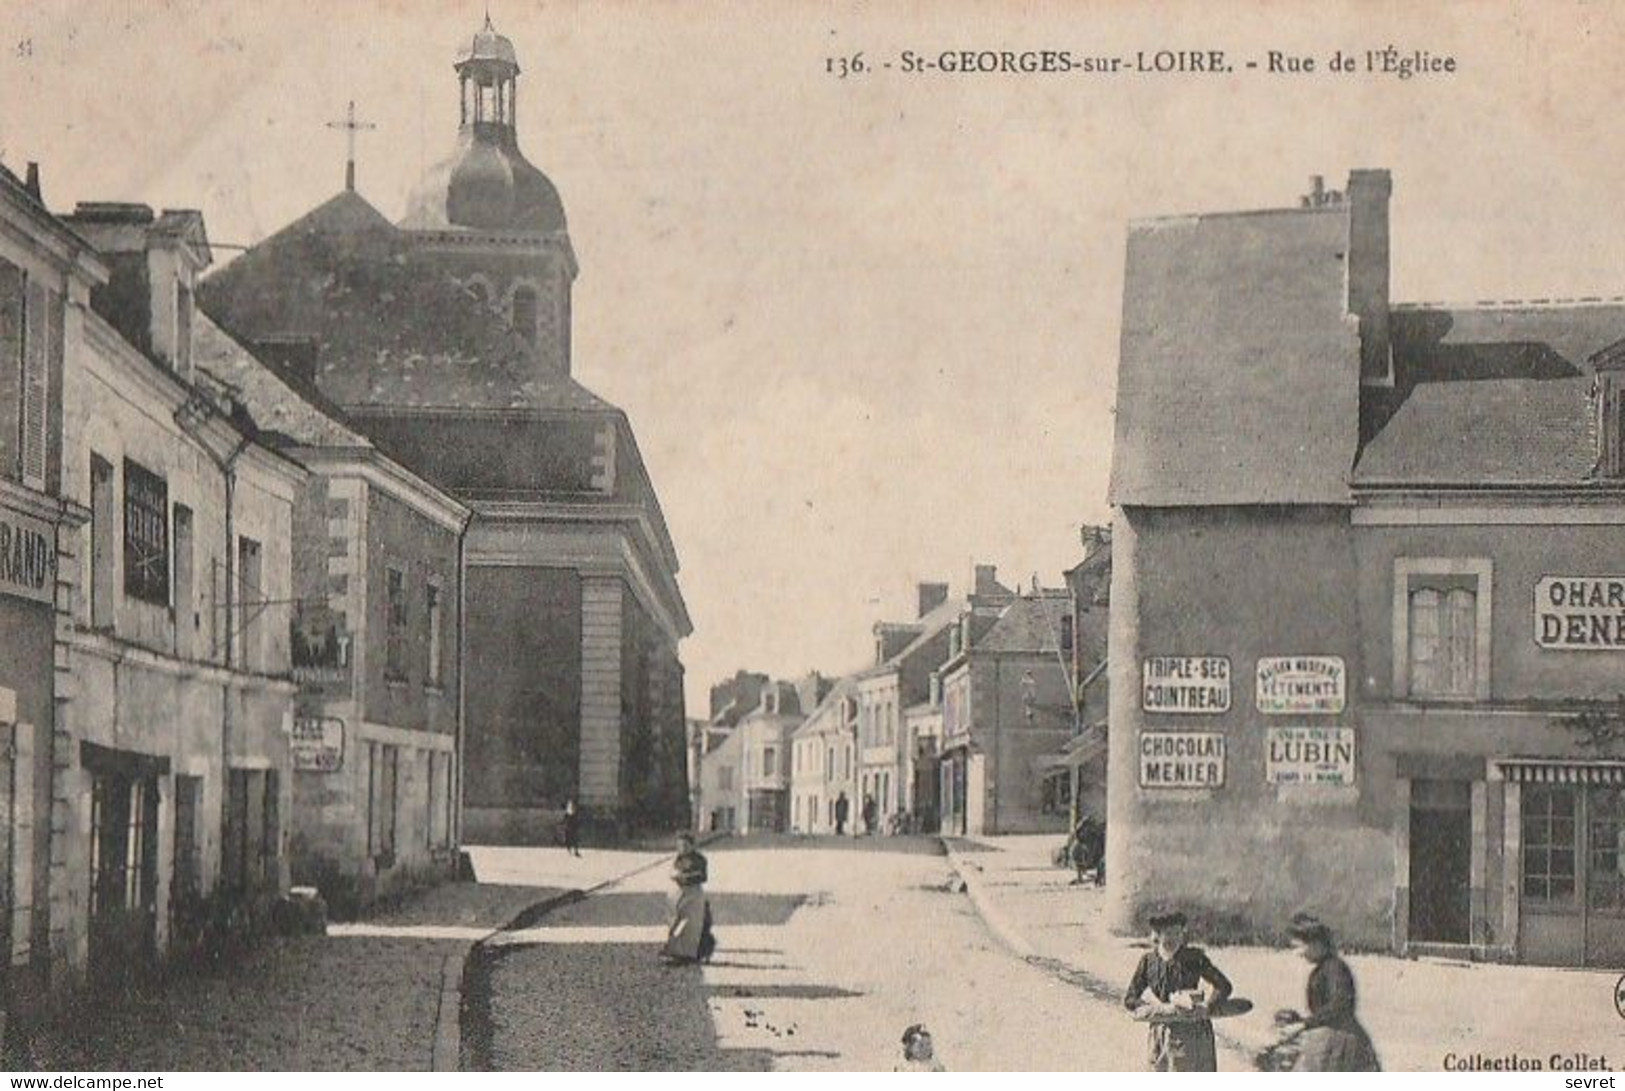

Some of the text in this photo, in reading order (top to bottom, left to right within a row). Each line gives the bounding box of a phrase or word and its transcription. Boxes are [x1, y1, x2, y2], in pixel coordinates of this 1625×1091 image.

[1144, 684, 1228, 709] COINTREAU
[1142, 736, 1222, 758] CHOCOLAT
[1269, 741, 1352, 764] LUBIN
[1146, 761, 1219, 783] MENIER
